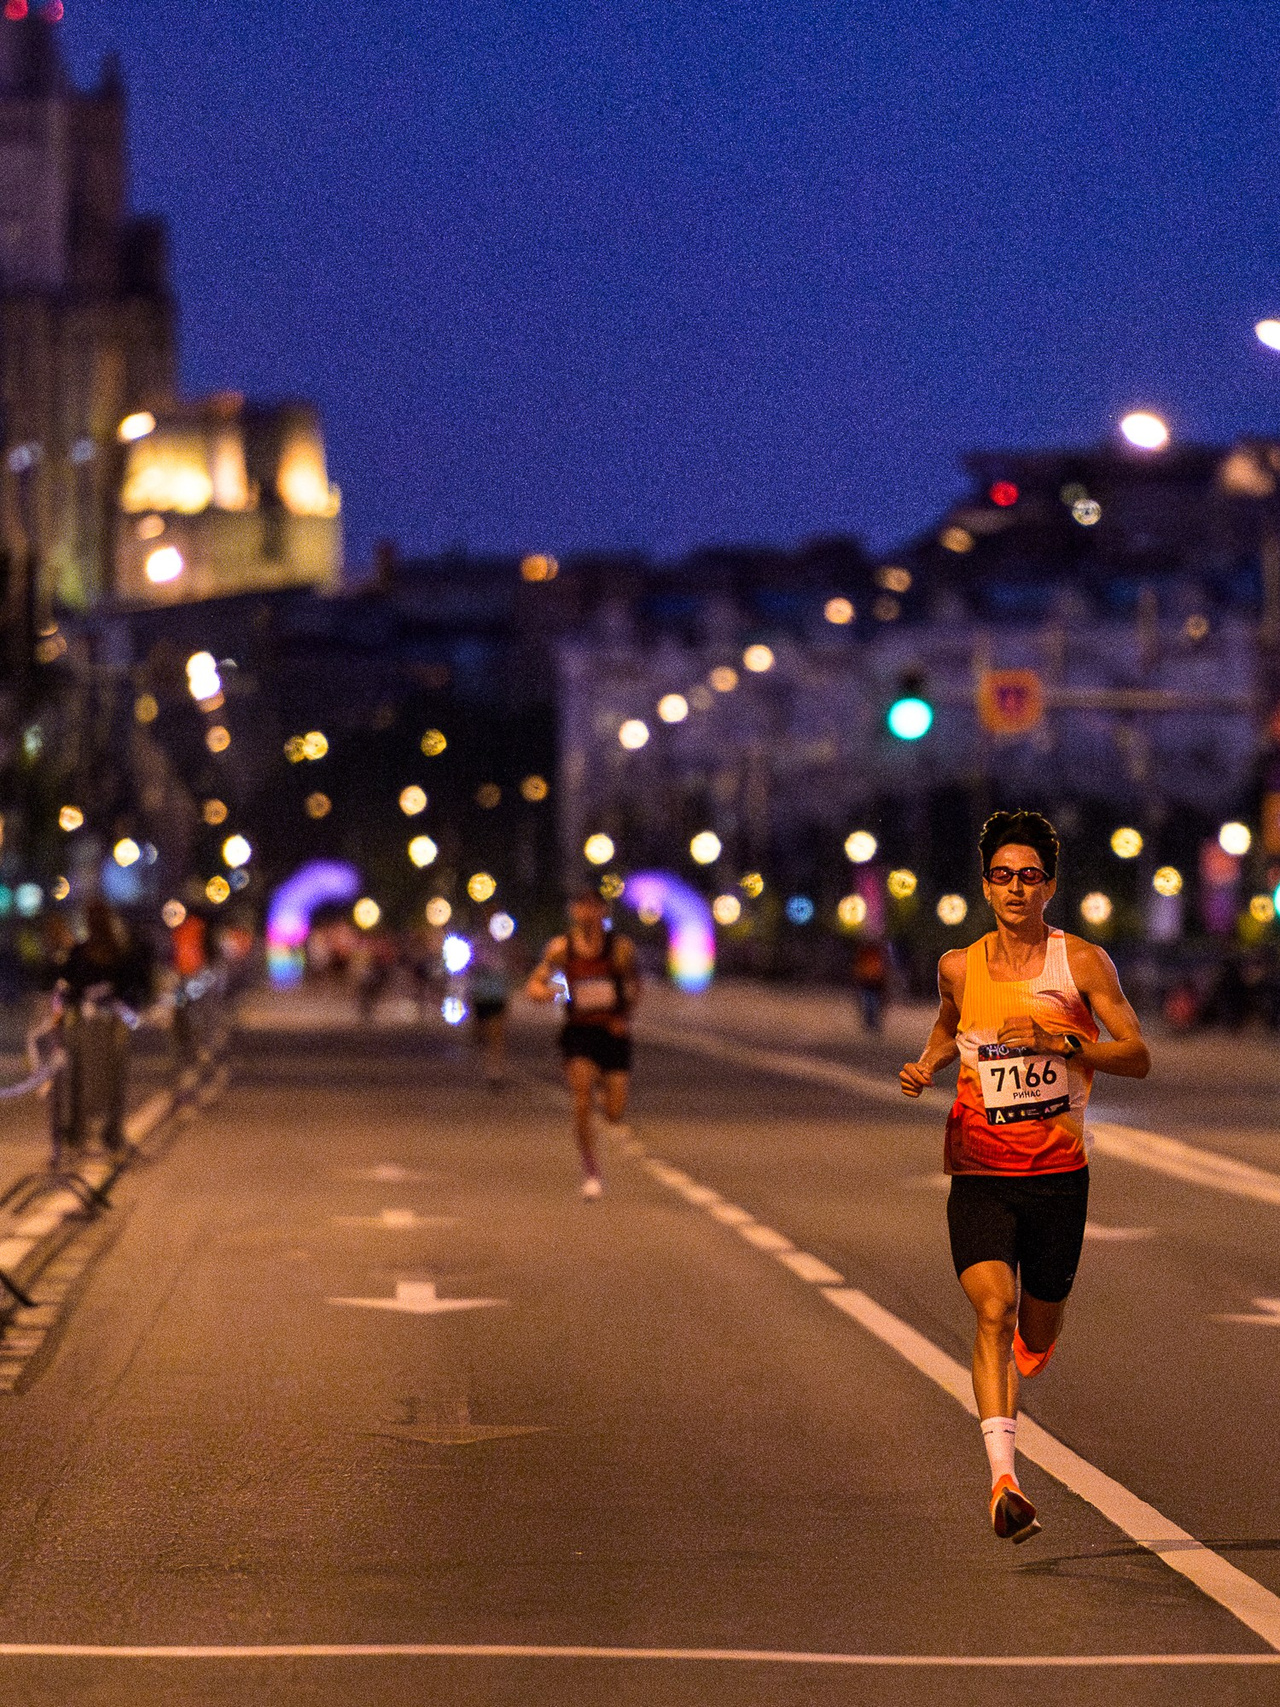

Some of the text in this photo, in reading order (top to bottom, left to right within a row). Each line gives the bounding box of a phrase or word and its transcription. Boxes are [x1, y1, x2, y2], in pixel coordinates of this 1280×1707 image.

[991, 1060, 1057, 1092] 7166
[1013, 1089, 1041, 1100] РИНАС
[995, 1110, 1006, 1124] A
